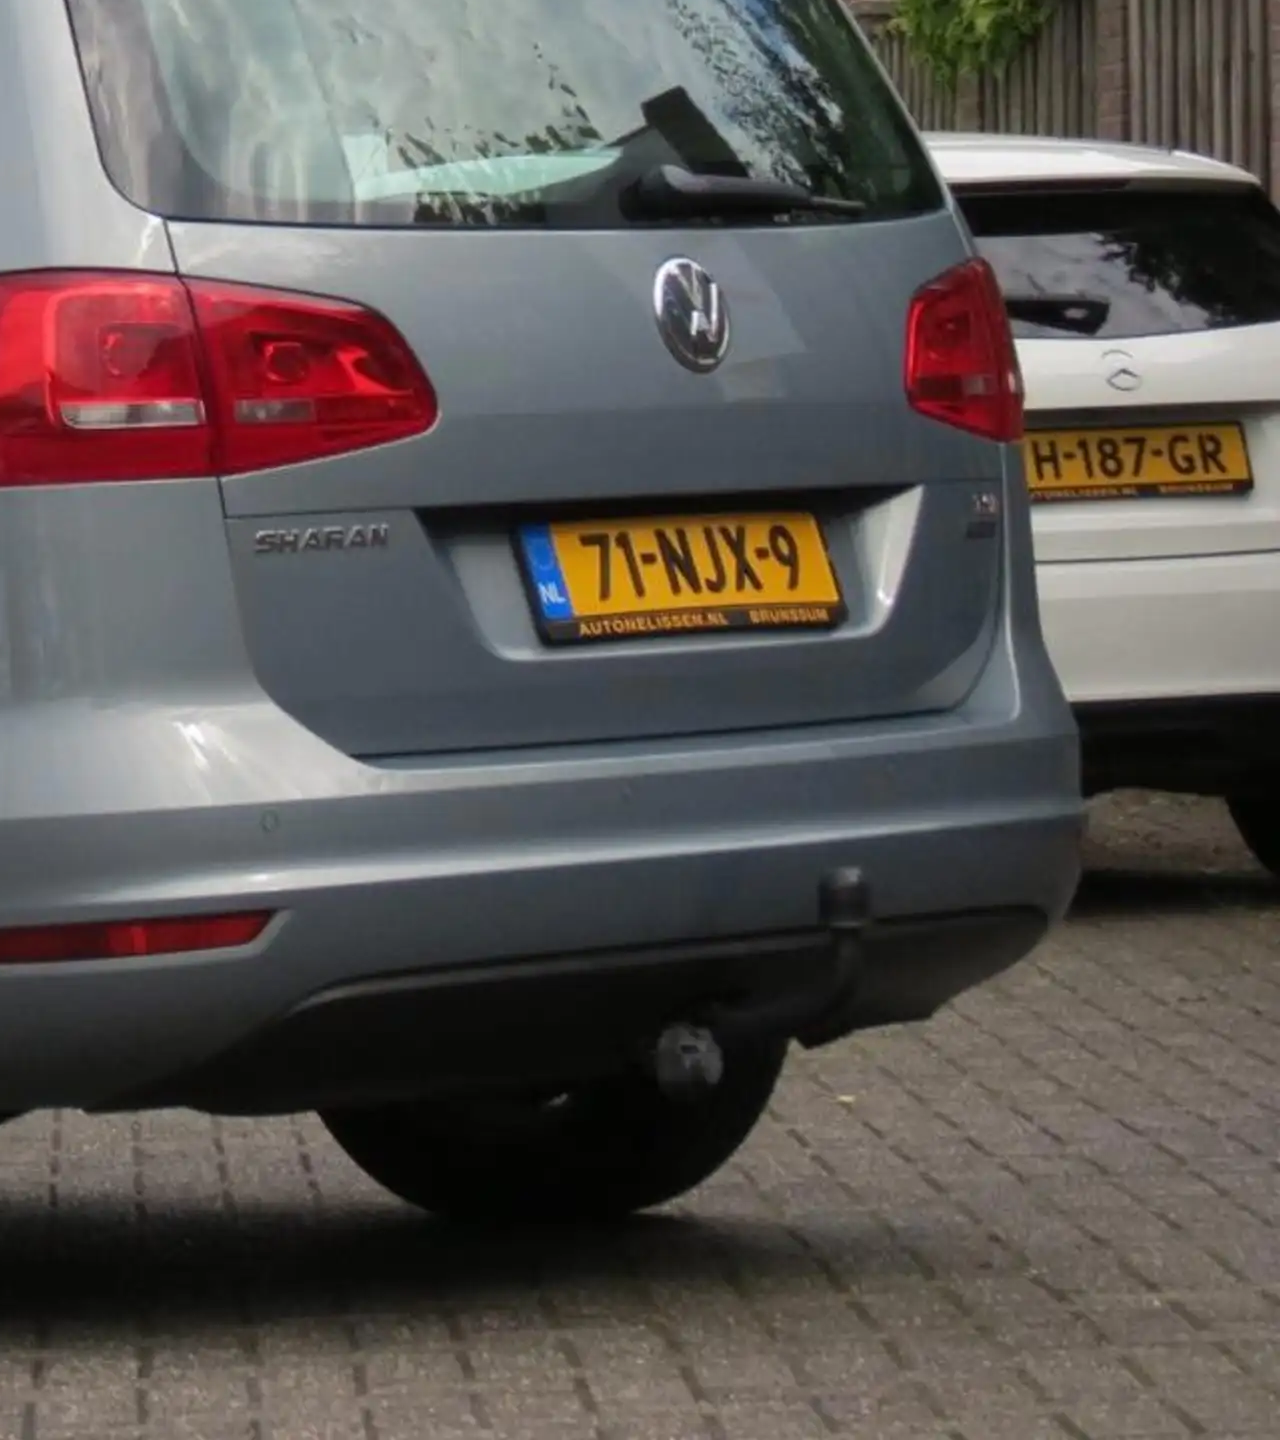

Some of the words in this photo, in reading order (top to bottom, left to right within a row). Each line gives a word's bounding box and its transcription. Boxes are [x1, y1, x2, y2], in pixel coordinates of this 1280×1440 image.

[1031, 432, 1228, 480] H-187-GR
[255, 523, 389, 553] SHARAN
[578, 524, 800, 601] 71-NJX-9
[538, 582, 566, 605] NL
